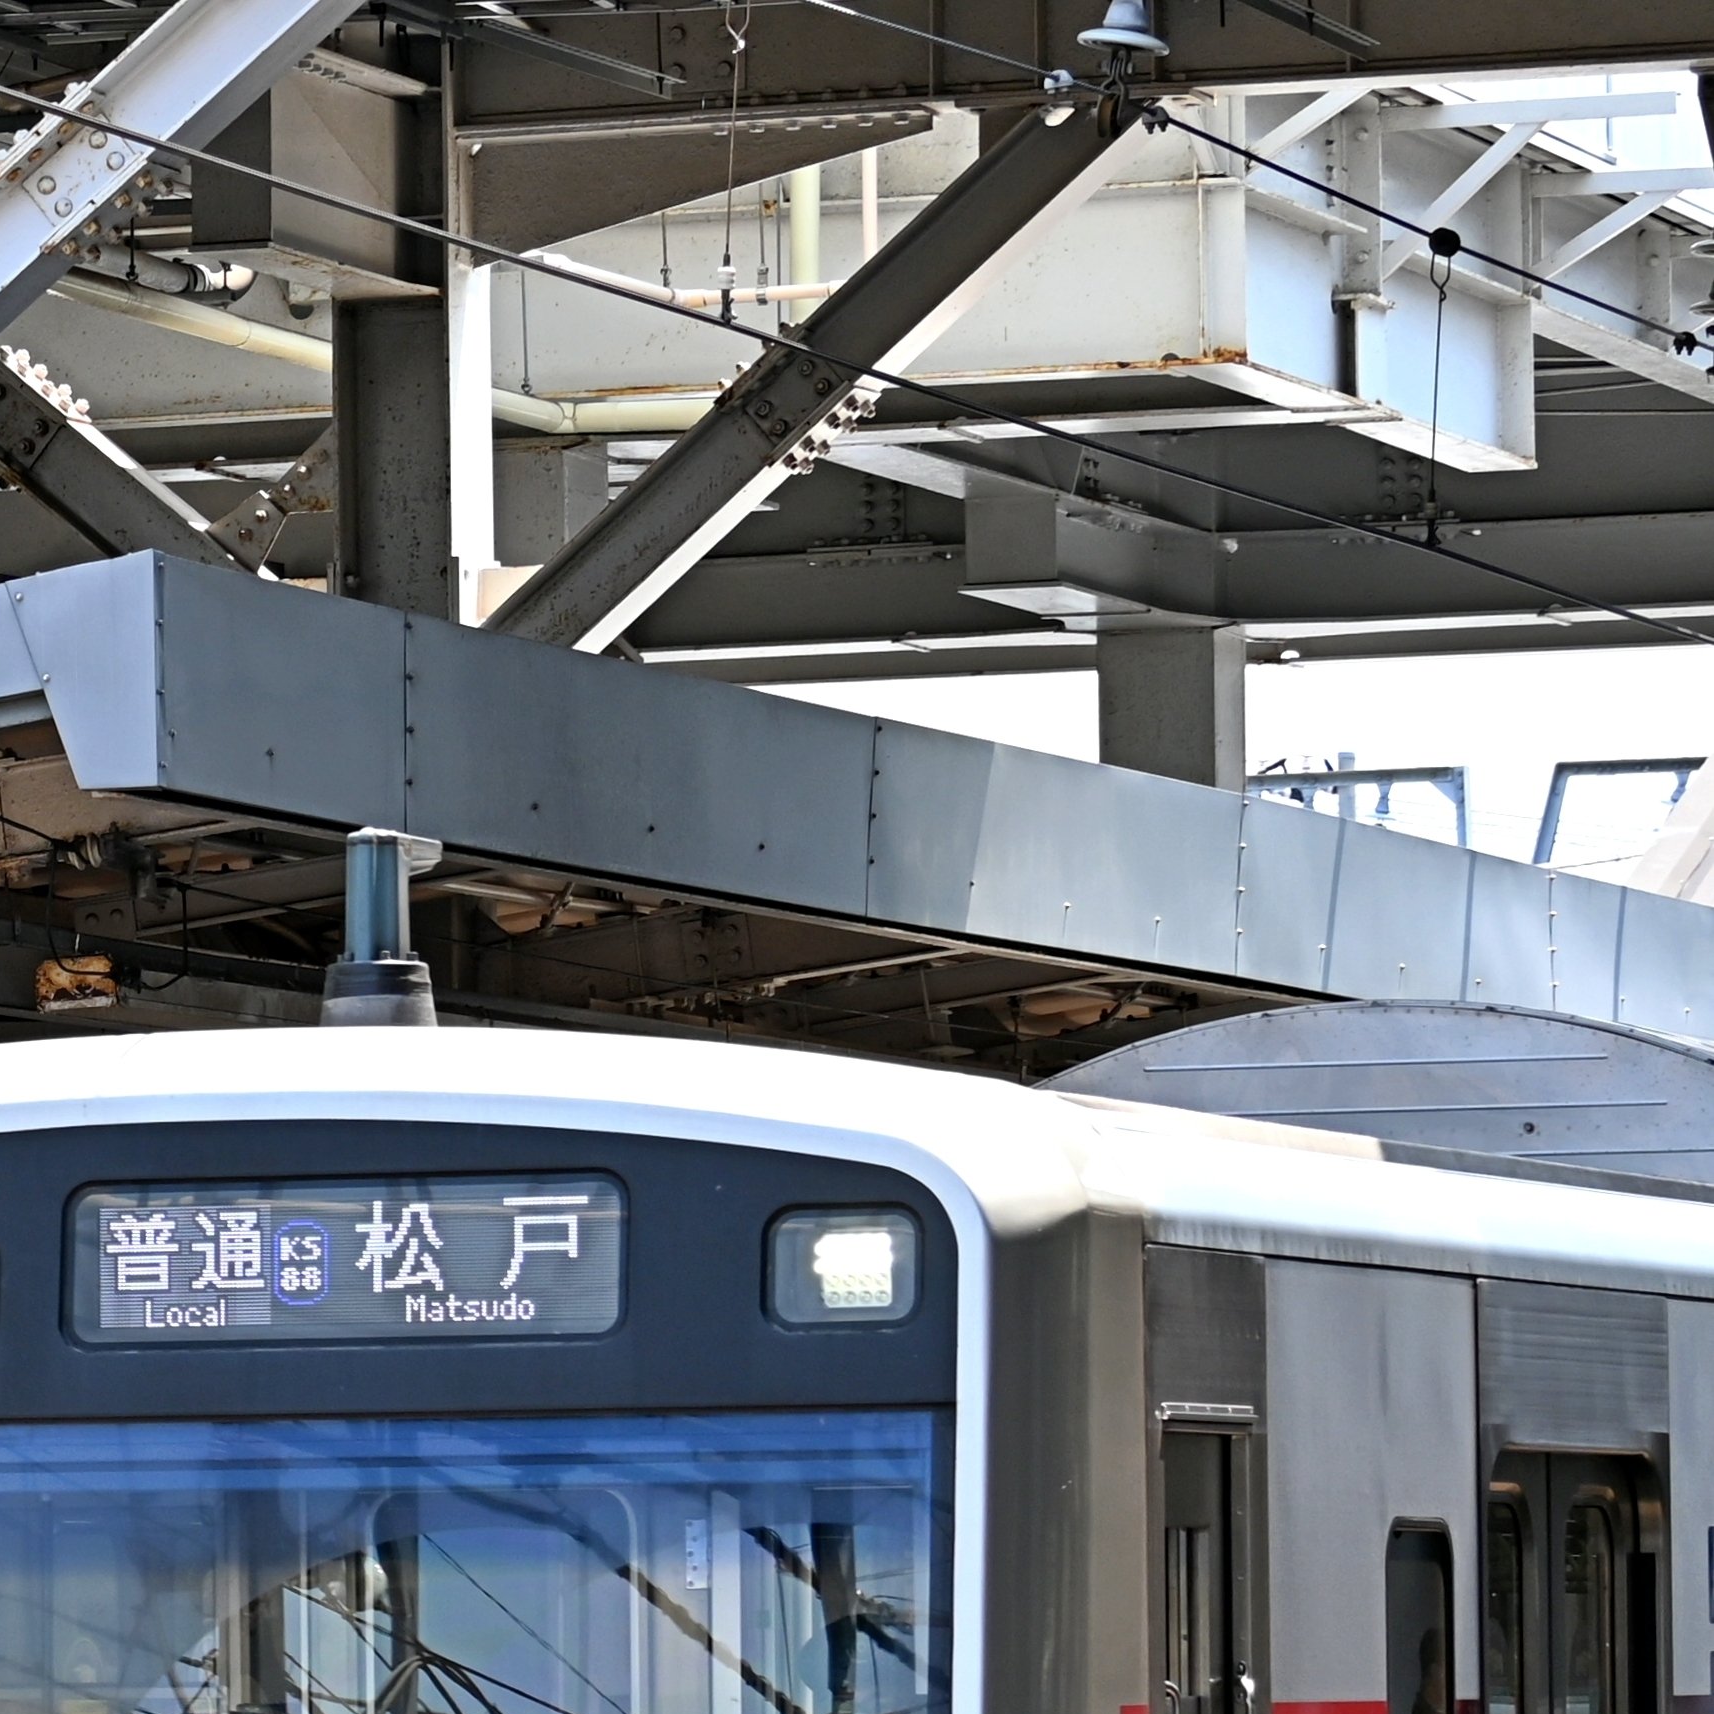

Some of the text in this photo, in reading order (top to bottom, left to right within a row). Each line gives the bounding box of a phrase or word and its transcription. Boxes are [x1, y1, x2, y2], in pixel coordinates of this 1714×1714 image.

[105, 1195, 589, 1293] 普通 松戸
[279, 1235, 322, 1261] KS
[279, 1267, 322, 1291] 88
[144, 1293, 536, 1328] Local Matsudo
